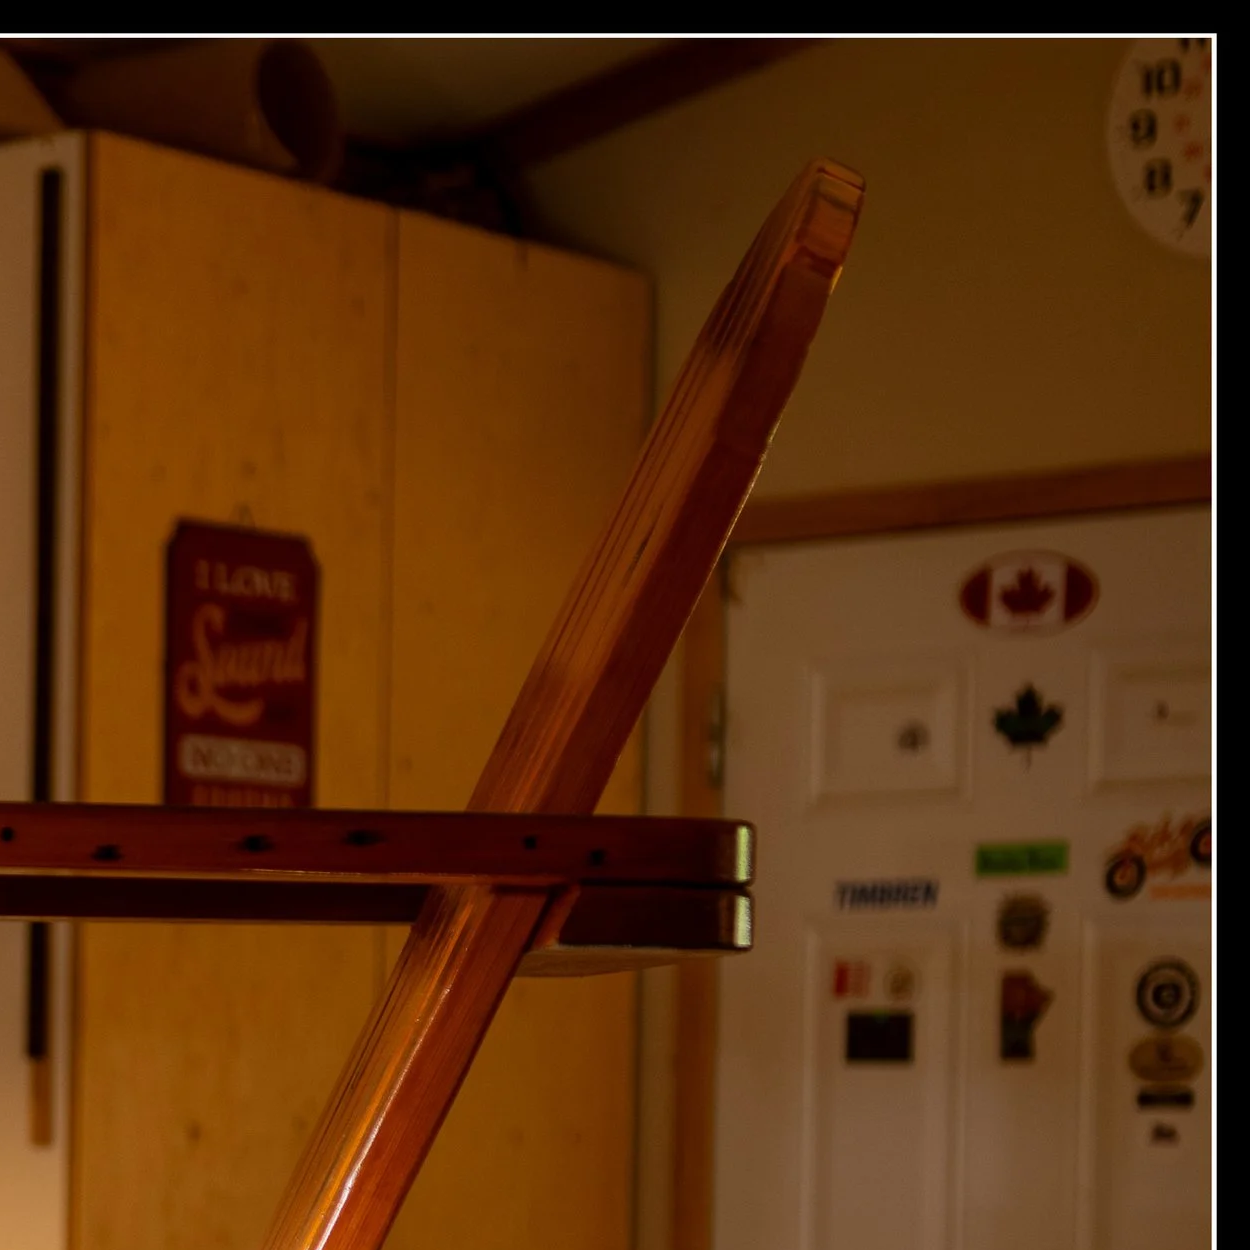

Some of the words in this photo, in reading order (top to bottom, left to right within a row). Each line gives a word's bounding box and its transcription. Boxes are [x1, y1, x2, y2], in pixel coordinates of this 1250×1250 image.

[1139, 58, 1181, 97] 10
[1129, 108, 1158, 150] 9
[1143, 157, 1172, 197] 8
[195, 559, 209, 590] I
[213, 562, 297, 602] LOVE
